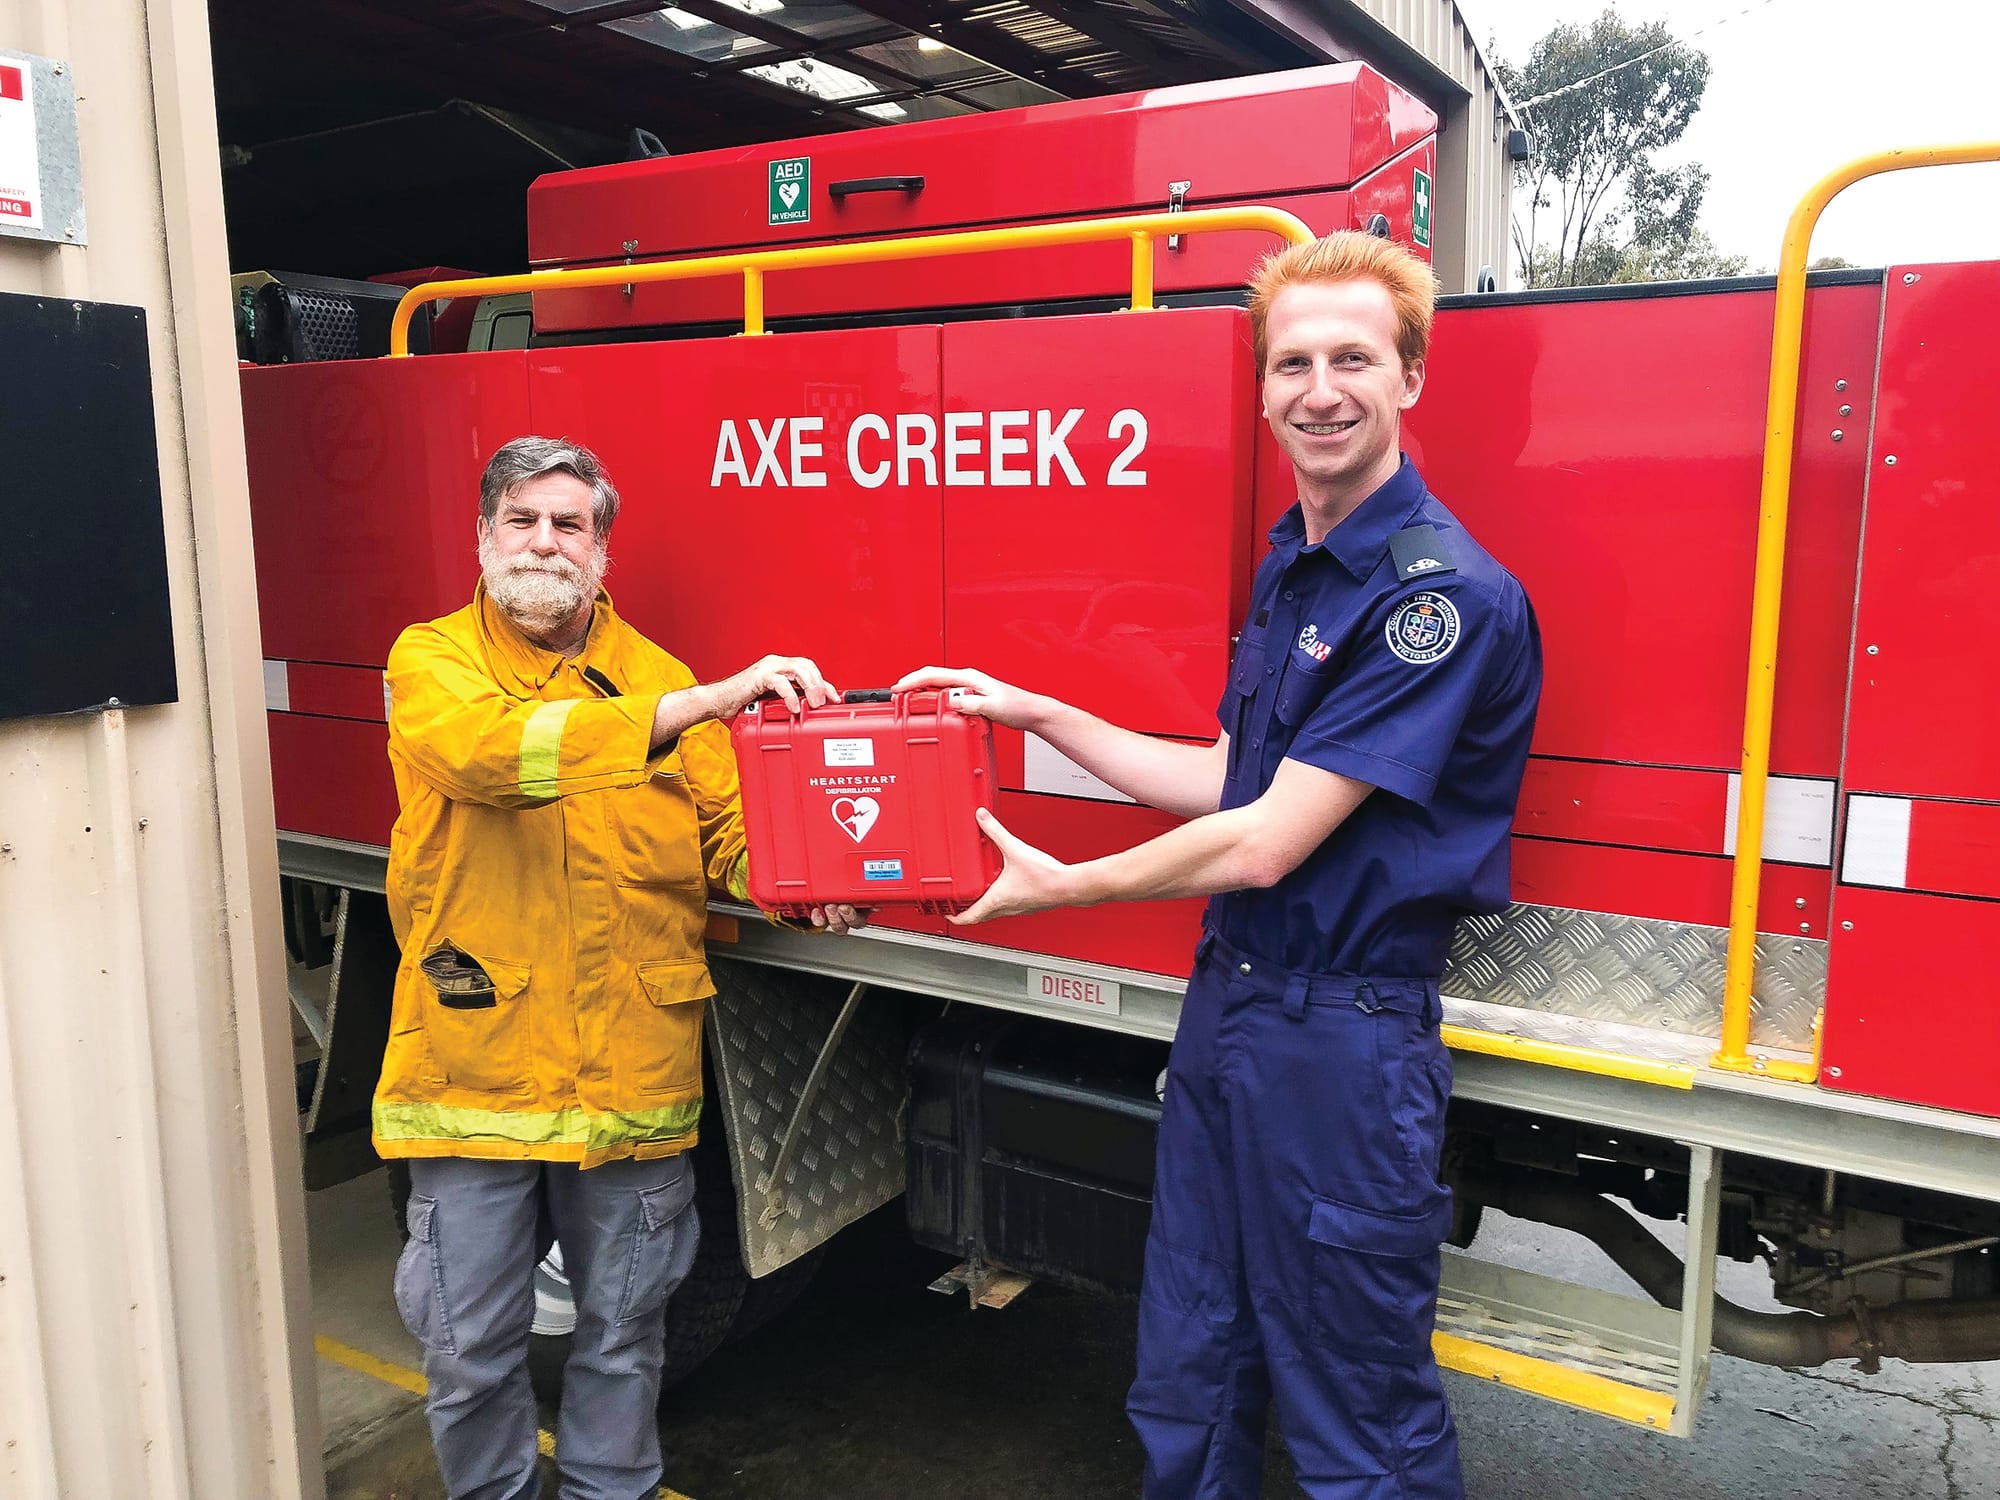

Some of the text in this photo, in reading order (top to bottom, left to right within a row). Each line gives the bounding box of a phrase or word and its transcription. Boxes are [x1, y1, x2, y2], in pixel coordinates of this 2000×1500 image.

[775, 162, 804, 179] AED
[780, 210, 807, 219] VEHICLE
[710, 408, 1149, 489] AXE CREEK 2
[1436, 600, 1456, 642] AUTHORITY
[1396, 643, 1439, 660] VICTORIA
[809, 775, 897, 786] HEARTSTART
[825, 786, 882, 795] DEFIBRILLATOR
[1042, 975, 1105, 1005] DIESEL
